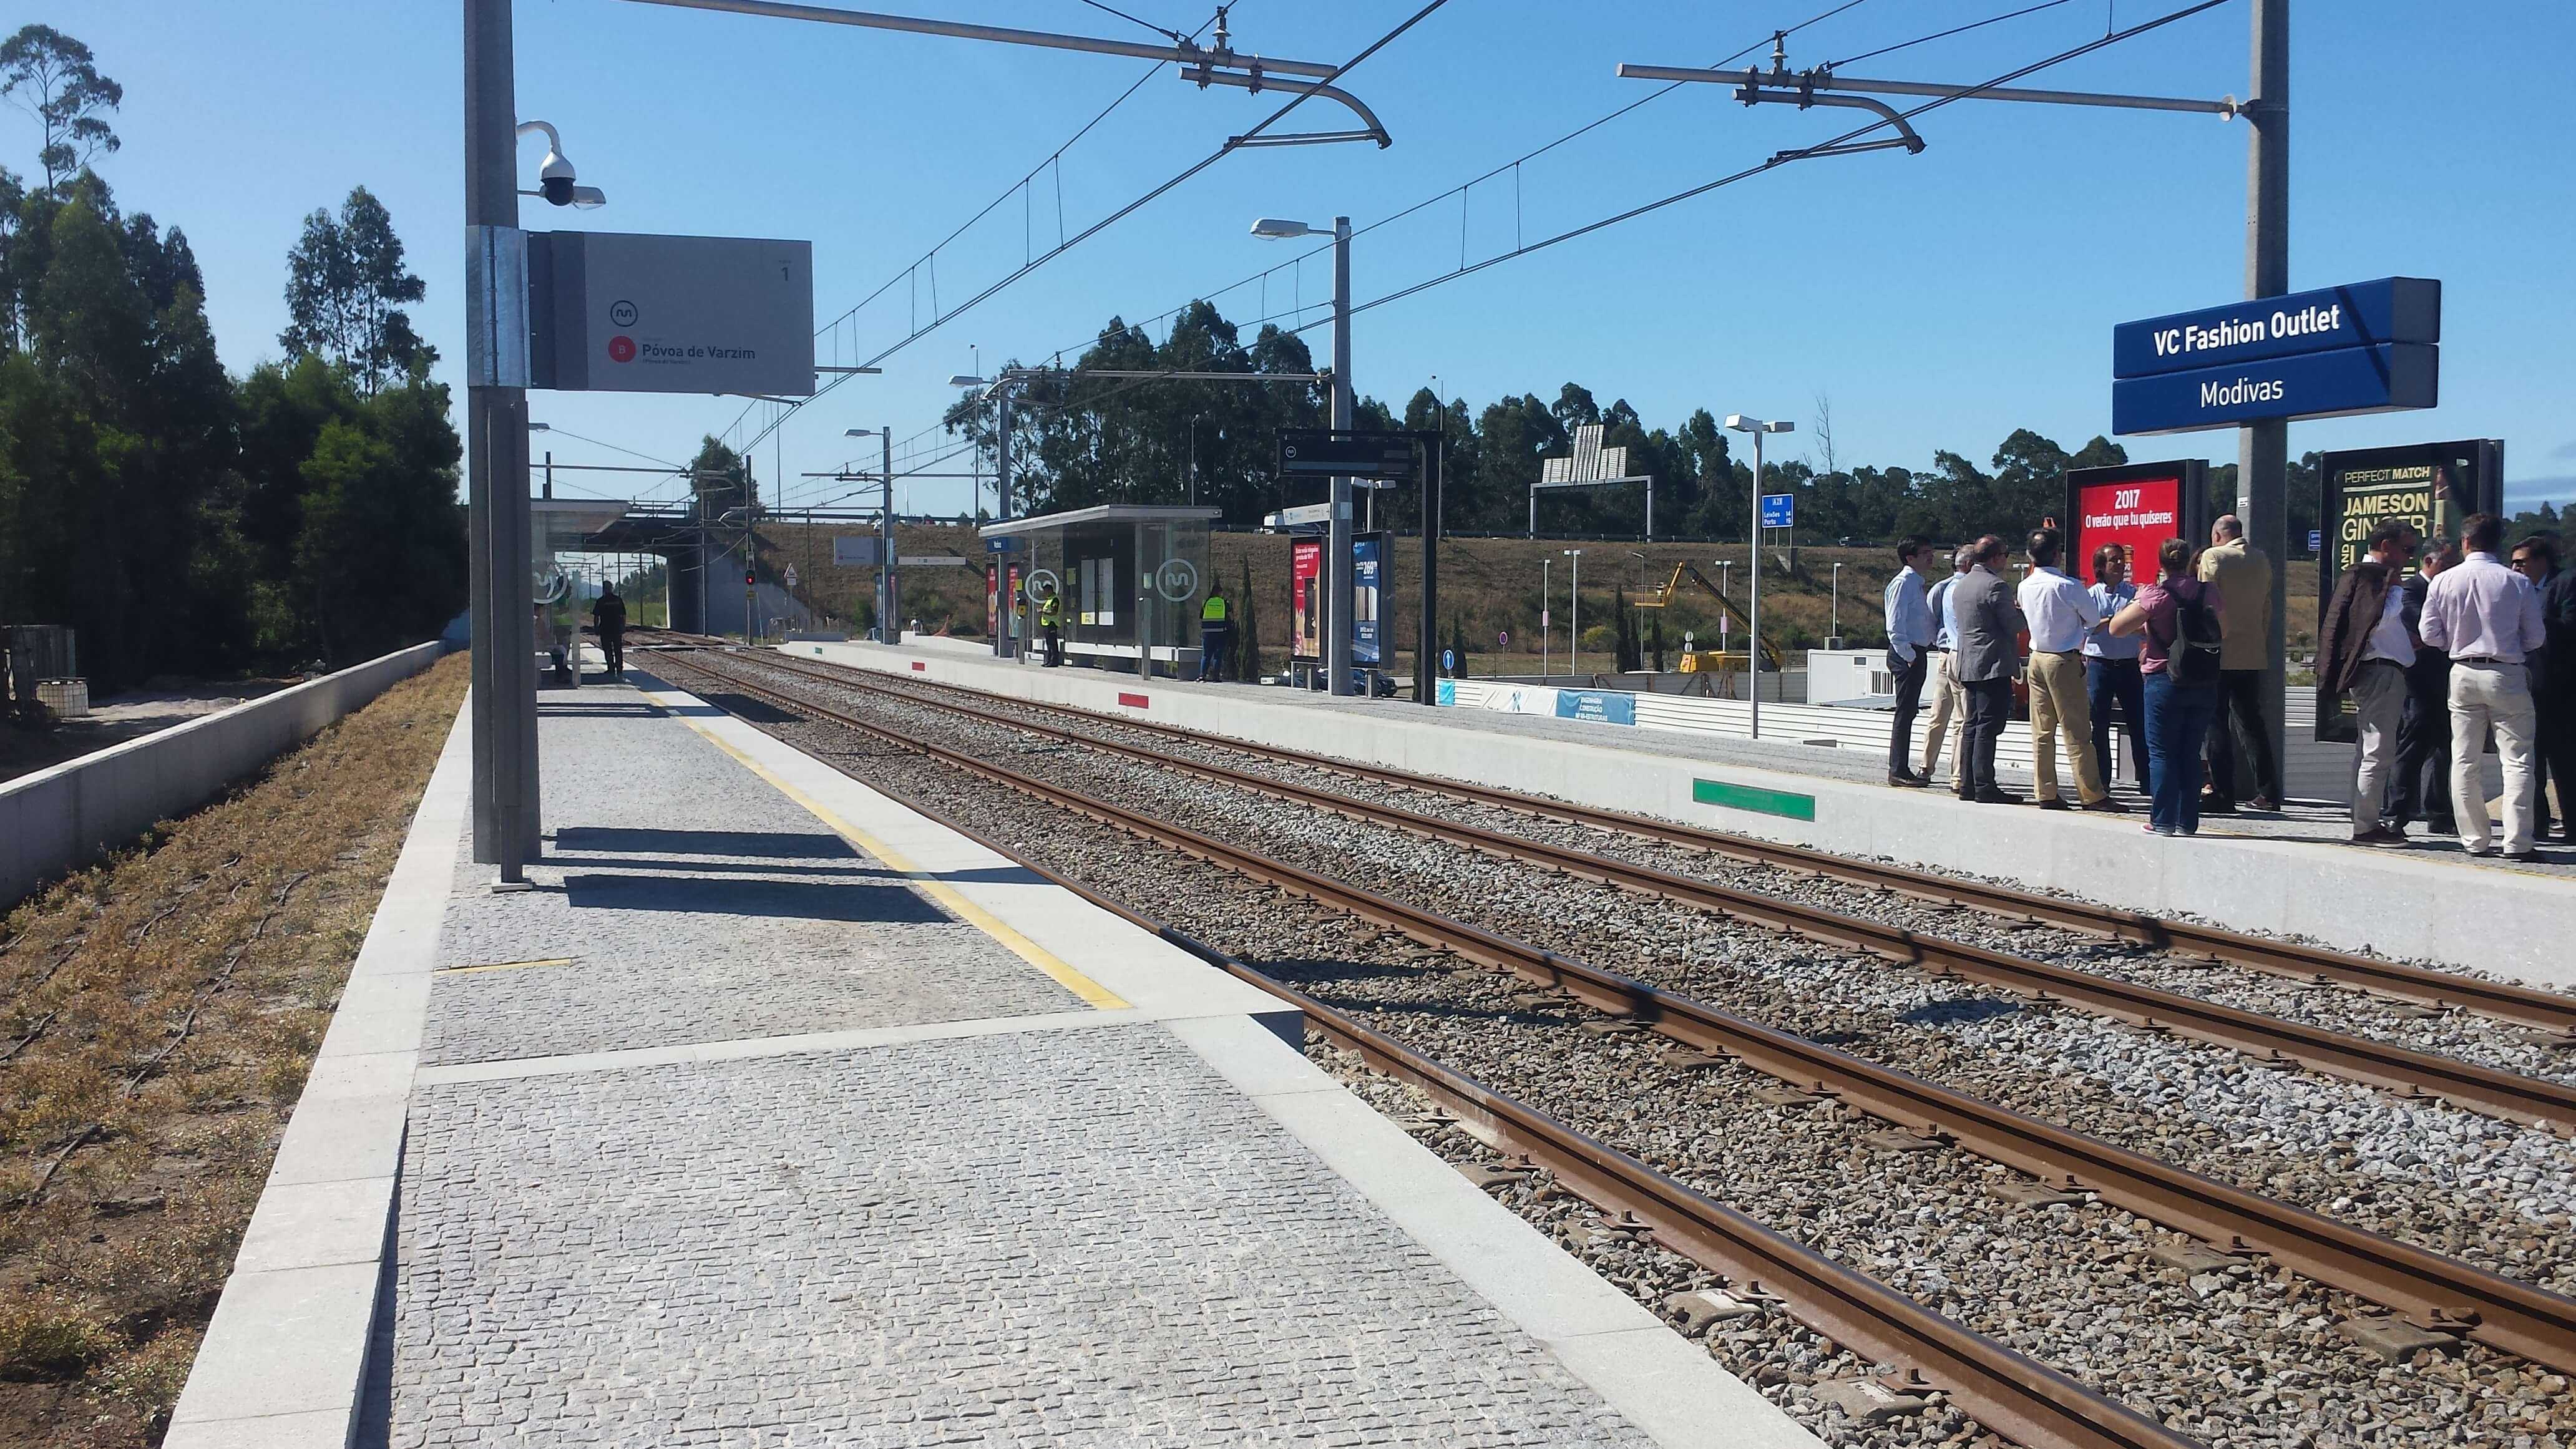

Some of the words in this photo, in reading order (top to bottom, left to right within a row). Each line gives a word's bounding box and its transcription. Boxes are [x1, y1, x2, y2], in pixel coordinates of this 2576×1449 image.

[781, 267, 788, 281] 1
[2154, 328, 2180, 356] VC
[2185, 318, 2265, 352] Fashion
[2271, 304, 2339, 338] Outlet
[618, 345, 626, 354] B
[642, 343, 683, 356] Póvoa
[688, 345, 705, 358] de
[708, 346, 756, 359] Varzim
[2200, 378, 2283, 408] Modivas
[2345, 469, 2391, 484] PERFECT
[2392, 466, 2431, 480] MATCH
[2115, 489, 2140, 509] 2017
[2343, 492, 2429, 517] JAMESON
[2086, 515, 2091, 528] O
[2092, 514, 2111, 527] verão
[2113, 515, 2129, 530] que
[2130, 512, 2139, 525] tu
[2139, 510, 2172, 529] quiseres
[2342, 514, 2427, 542] GINR
